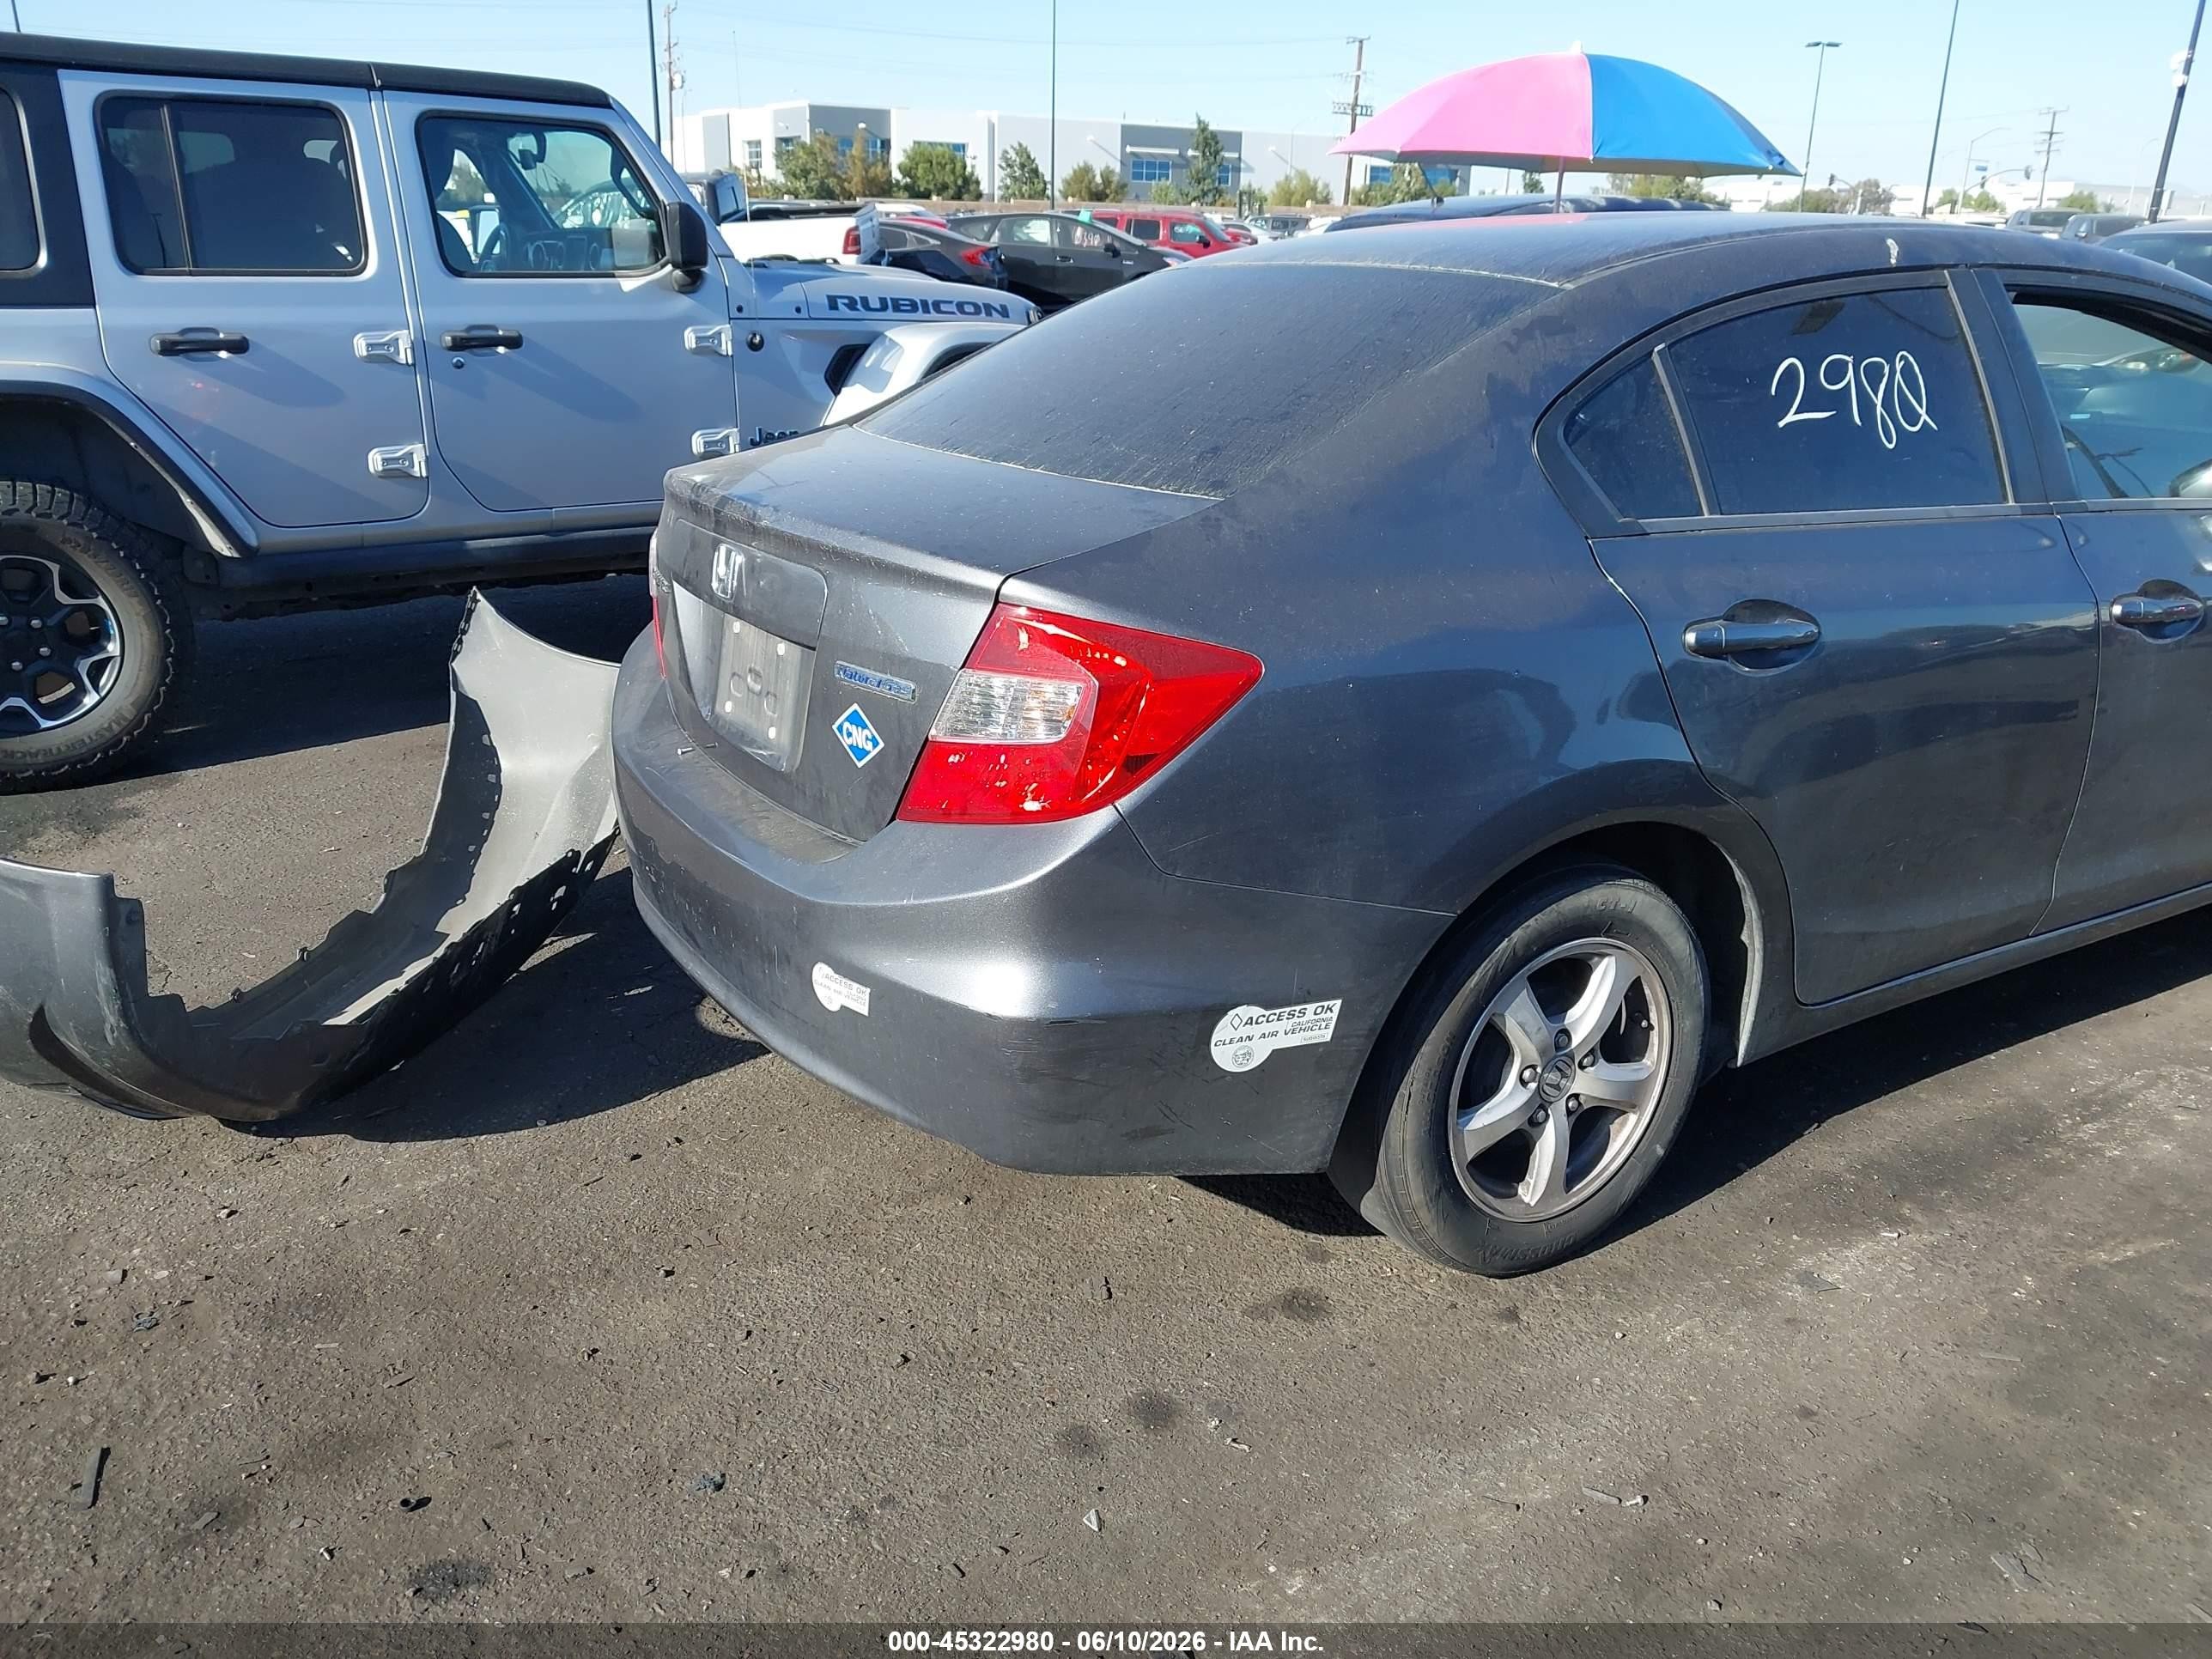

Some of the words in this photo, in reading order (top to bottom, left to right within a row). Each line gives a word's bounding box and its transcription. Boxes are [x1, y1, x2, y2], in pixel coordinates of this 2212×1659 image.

[826, 295, 1010, 319] RUBICON
[1771, 350, 1939, 449] 2980
[842, 721, 873, 752] CNG
[824, 973, 854, 991] ACCESS
[855, 987, 867, 997] OK
[1243, 1007, 1308, 1028] ACCESS
[1313, 1003, 1337, 1017] OK
[1291, 1017, 1334, 1028] CALIFORNIA
[1213, 1034, 1255, 1048] CLEAN
[1258, 1030, 1279, 1041] AIR
[1284, 1022, 1333, 1036] VEHICLE
